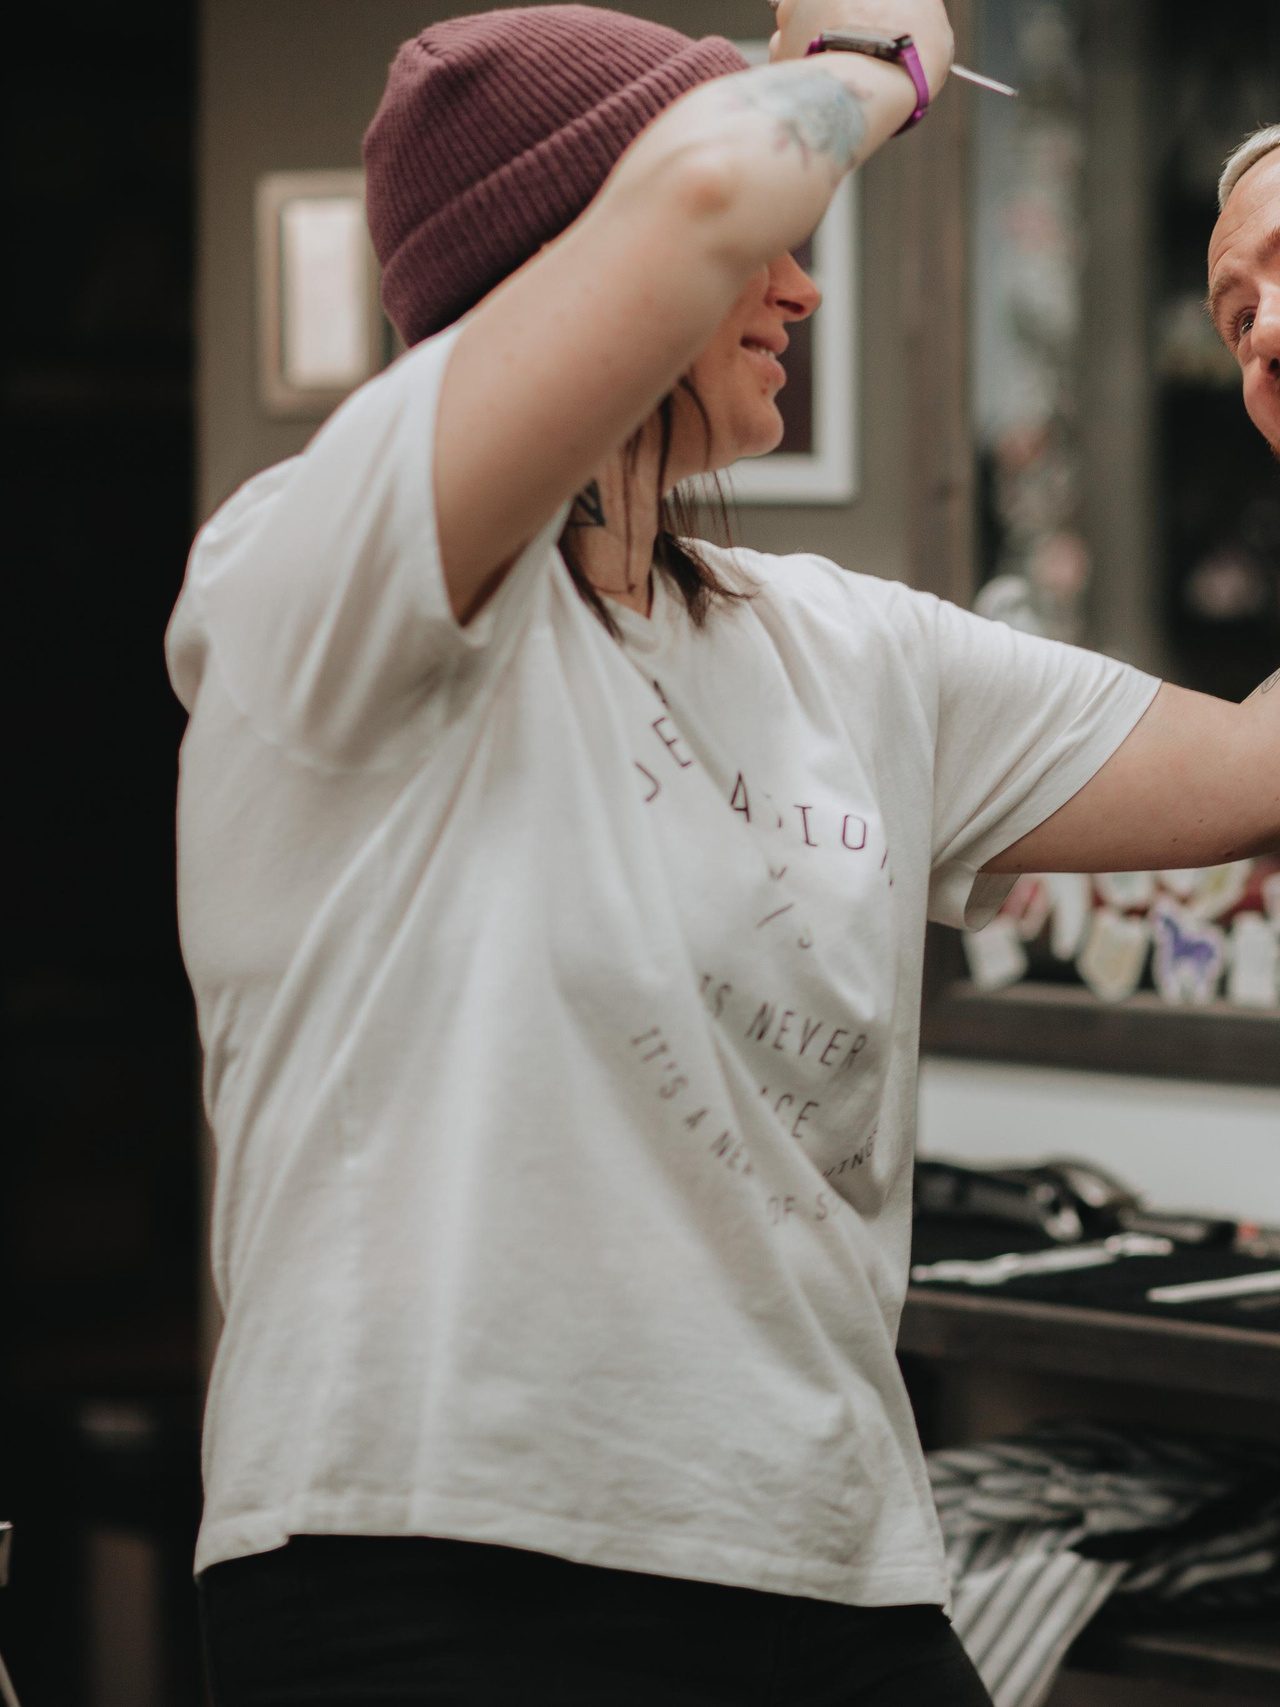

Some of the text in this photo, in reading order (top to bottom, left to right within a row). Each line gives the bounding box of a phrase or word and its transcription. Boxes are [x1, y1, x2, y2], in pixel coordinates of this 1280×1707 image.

[630, 1025, 689, 1100] IT'S
[683, 1107, 709, 1132] A
[745, 1001, 868, 1071] NEVER
